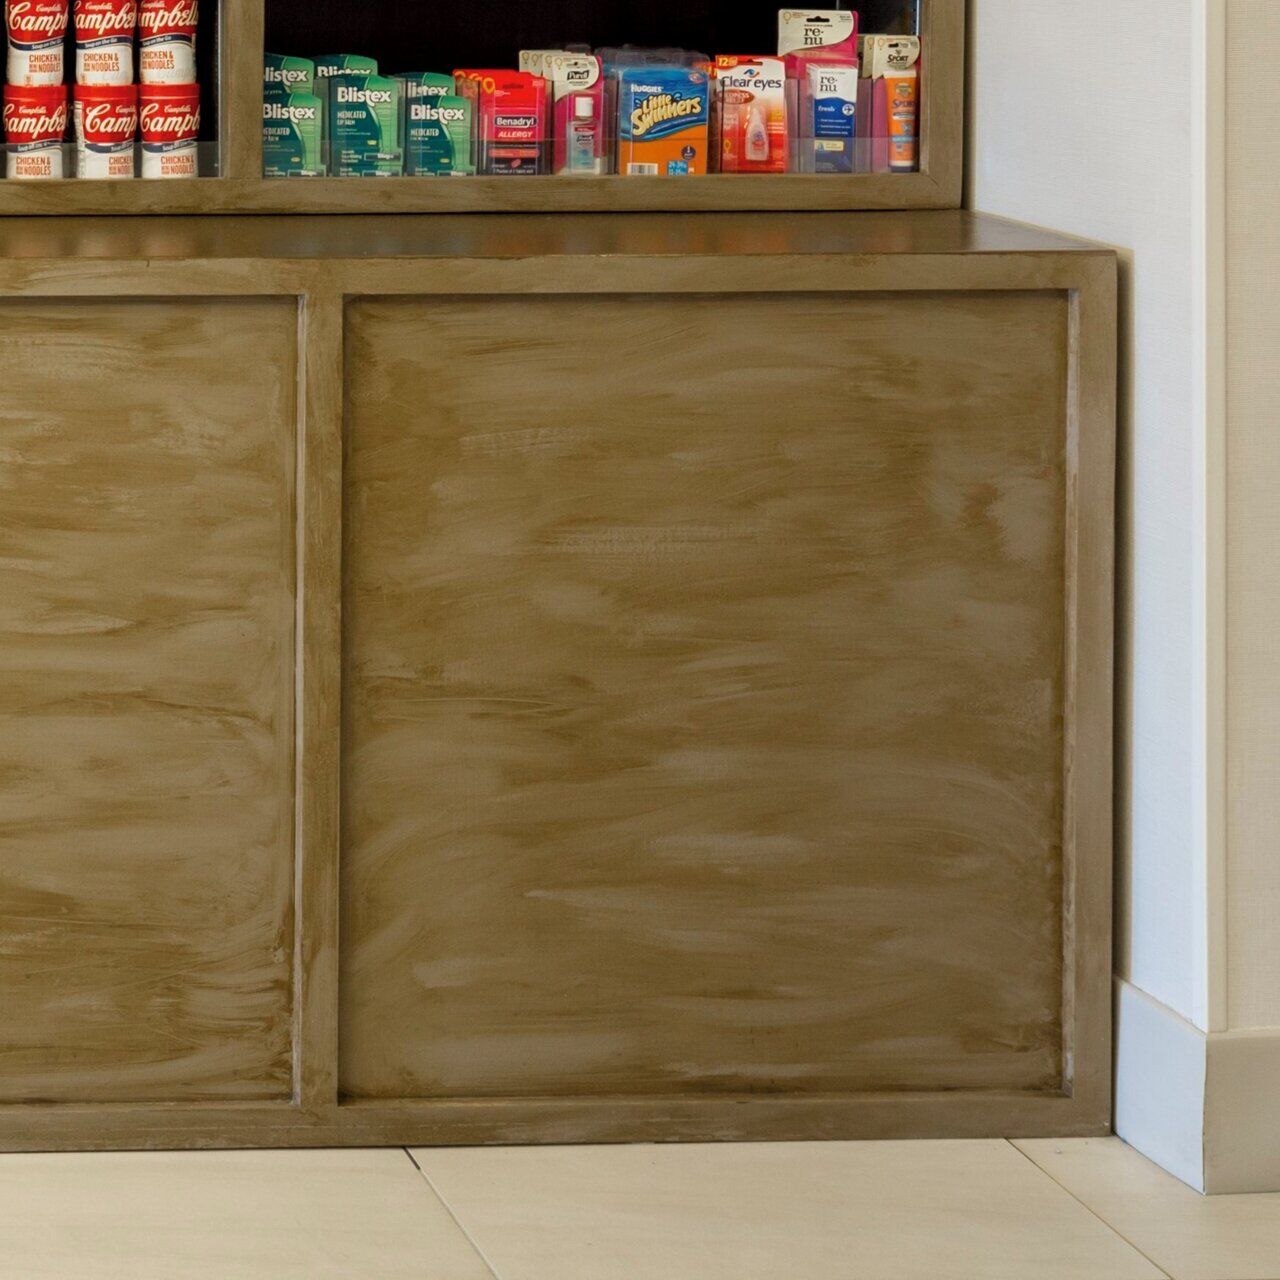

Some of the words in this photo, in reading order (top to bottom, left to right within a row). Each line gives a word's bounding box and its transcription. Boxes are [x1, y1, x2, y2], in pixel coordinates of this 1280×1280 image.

[83, 54, 111, 62] CHICKEN
[722, 76, 753, 89] Clear
[754, 78, 782, 90] eyes
[631, 84, 663, 93] HUGGIES
[337, 87, 391, 106] Blistex
[411, 105, 464, 123] Blistex
[497, 117, 535, 127] Benadryl
[410, 129, 439, 137] MEDICATED
